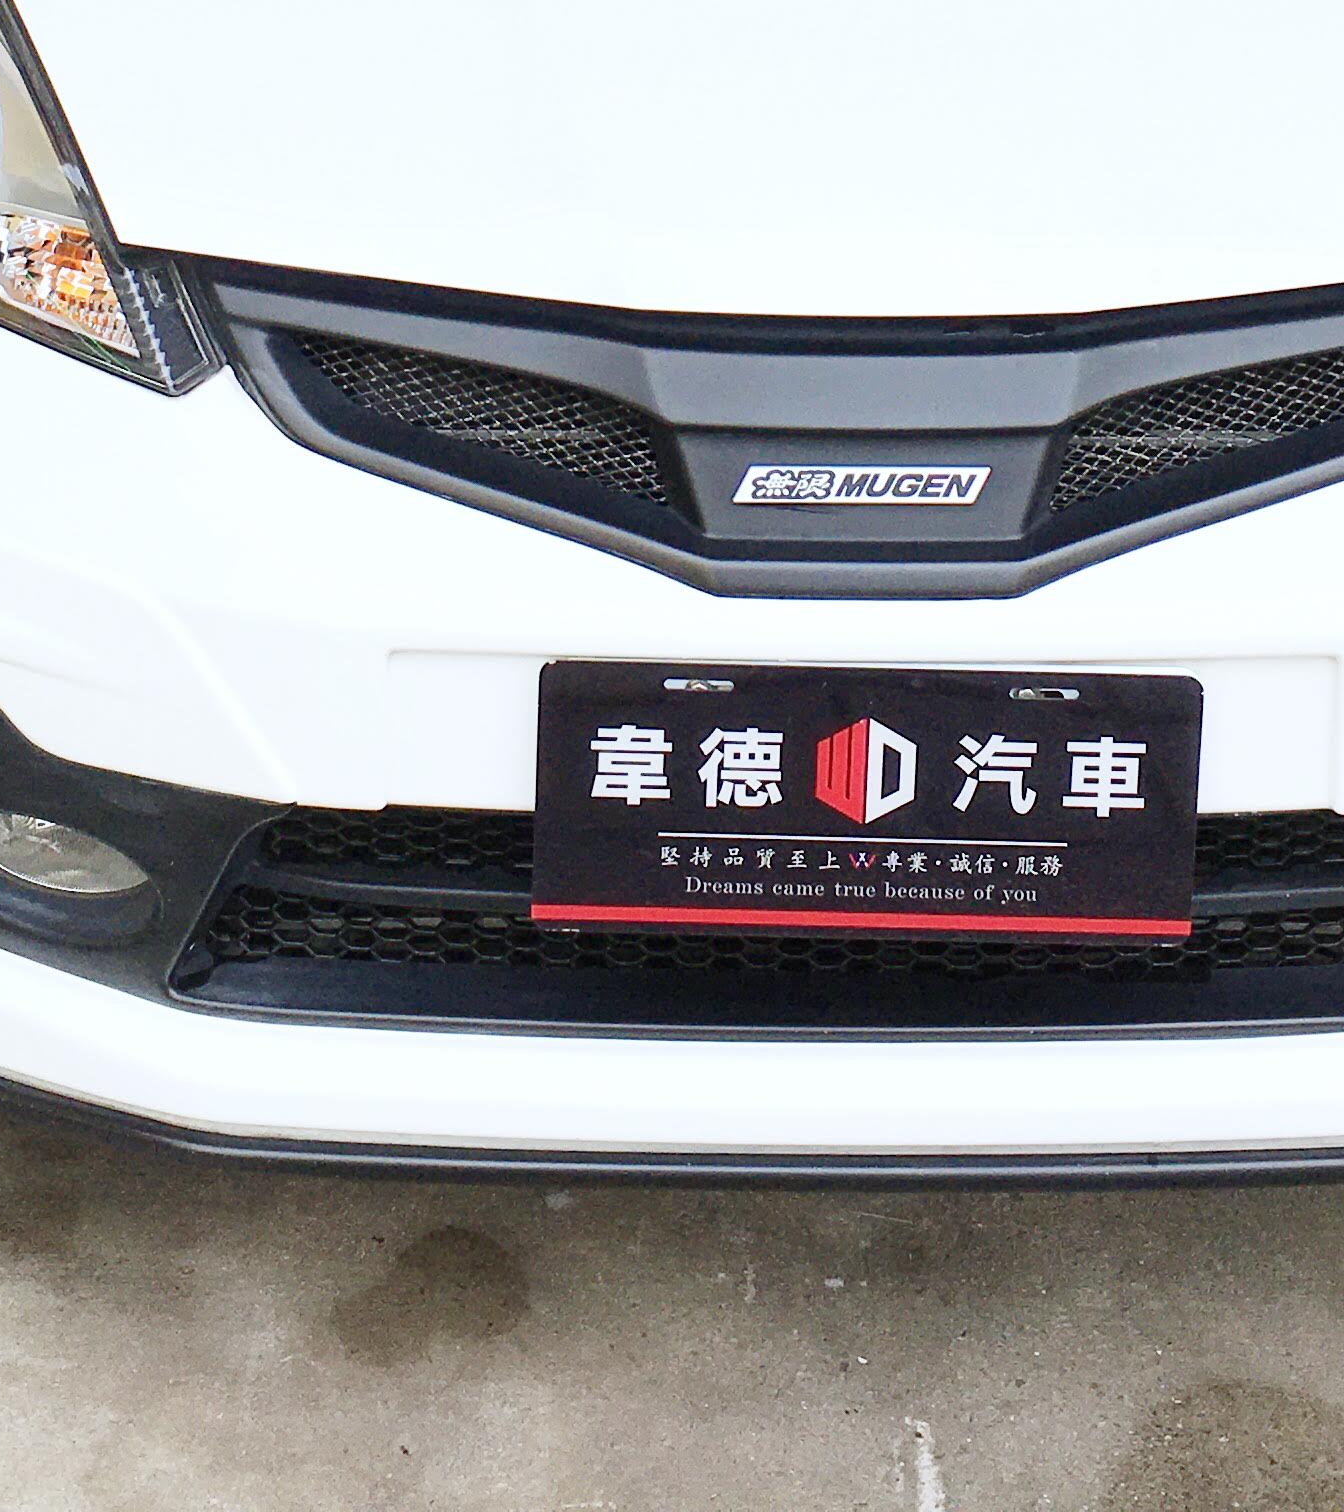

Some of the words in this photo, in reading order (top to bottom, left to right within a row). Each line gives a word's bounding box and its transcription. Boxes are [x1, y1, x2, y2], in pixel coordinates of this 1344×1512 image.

[834, 473, 978, 498] MUGEN
[589, 725, 785, 809] 韋德
[951, 733, 1149, 818] 汽車
[660, 846, 842, 871] 堅持品質至上
[685, 875, 763, 896] Dreams
[771, 884, 825, 897] came
[833, 881, 876, 899] true
[884, 882, 966, 901] because
[973, 883, 995, 901] of
[1001, 888, 1038, 906] you
